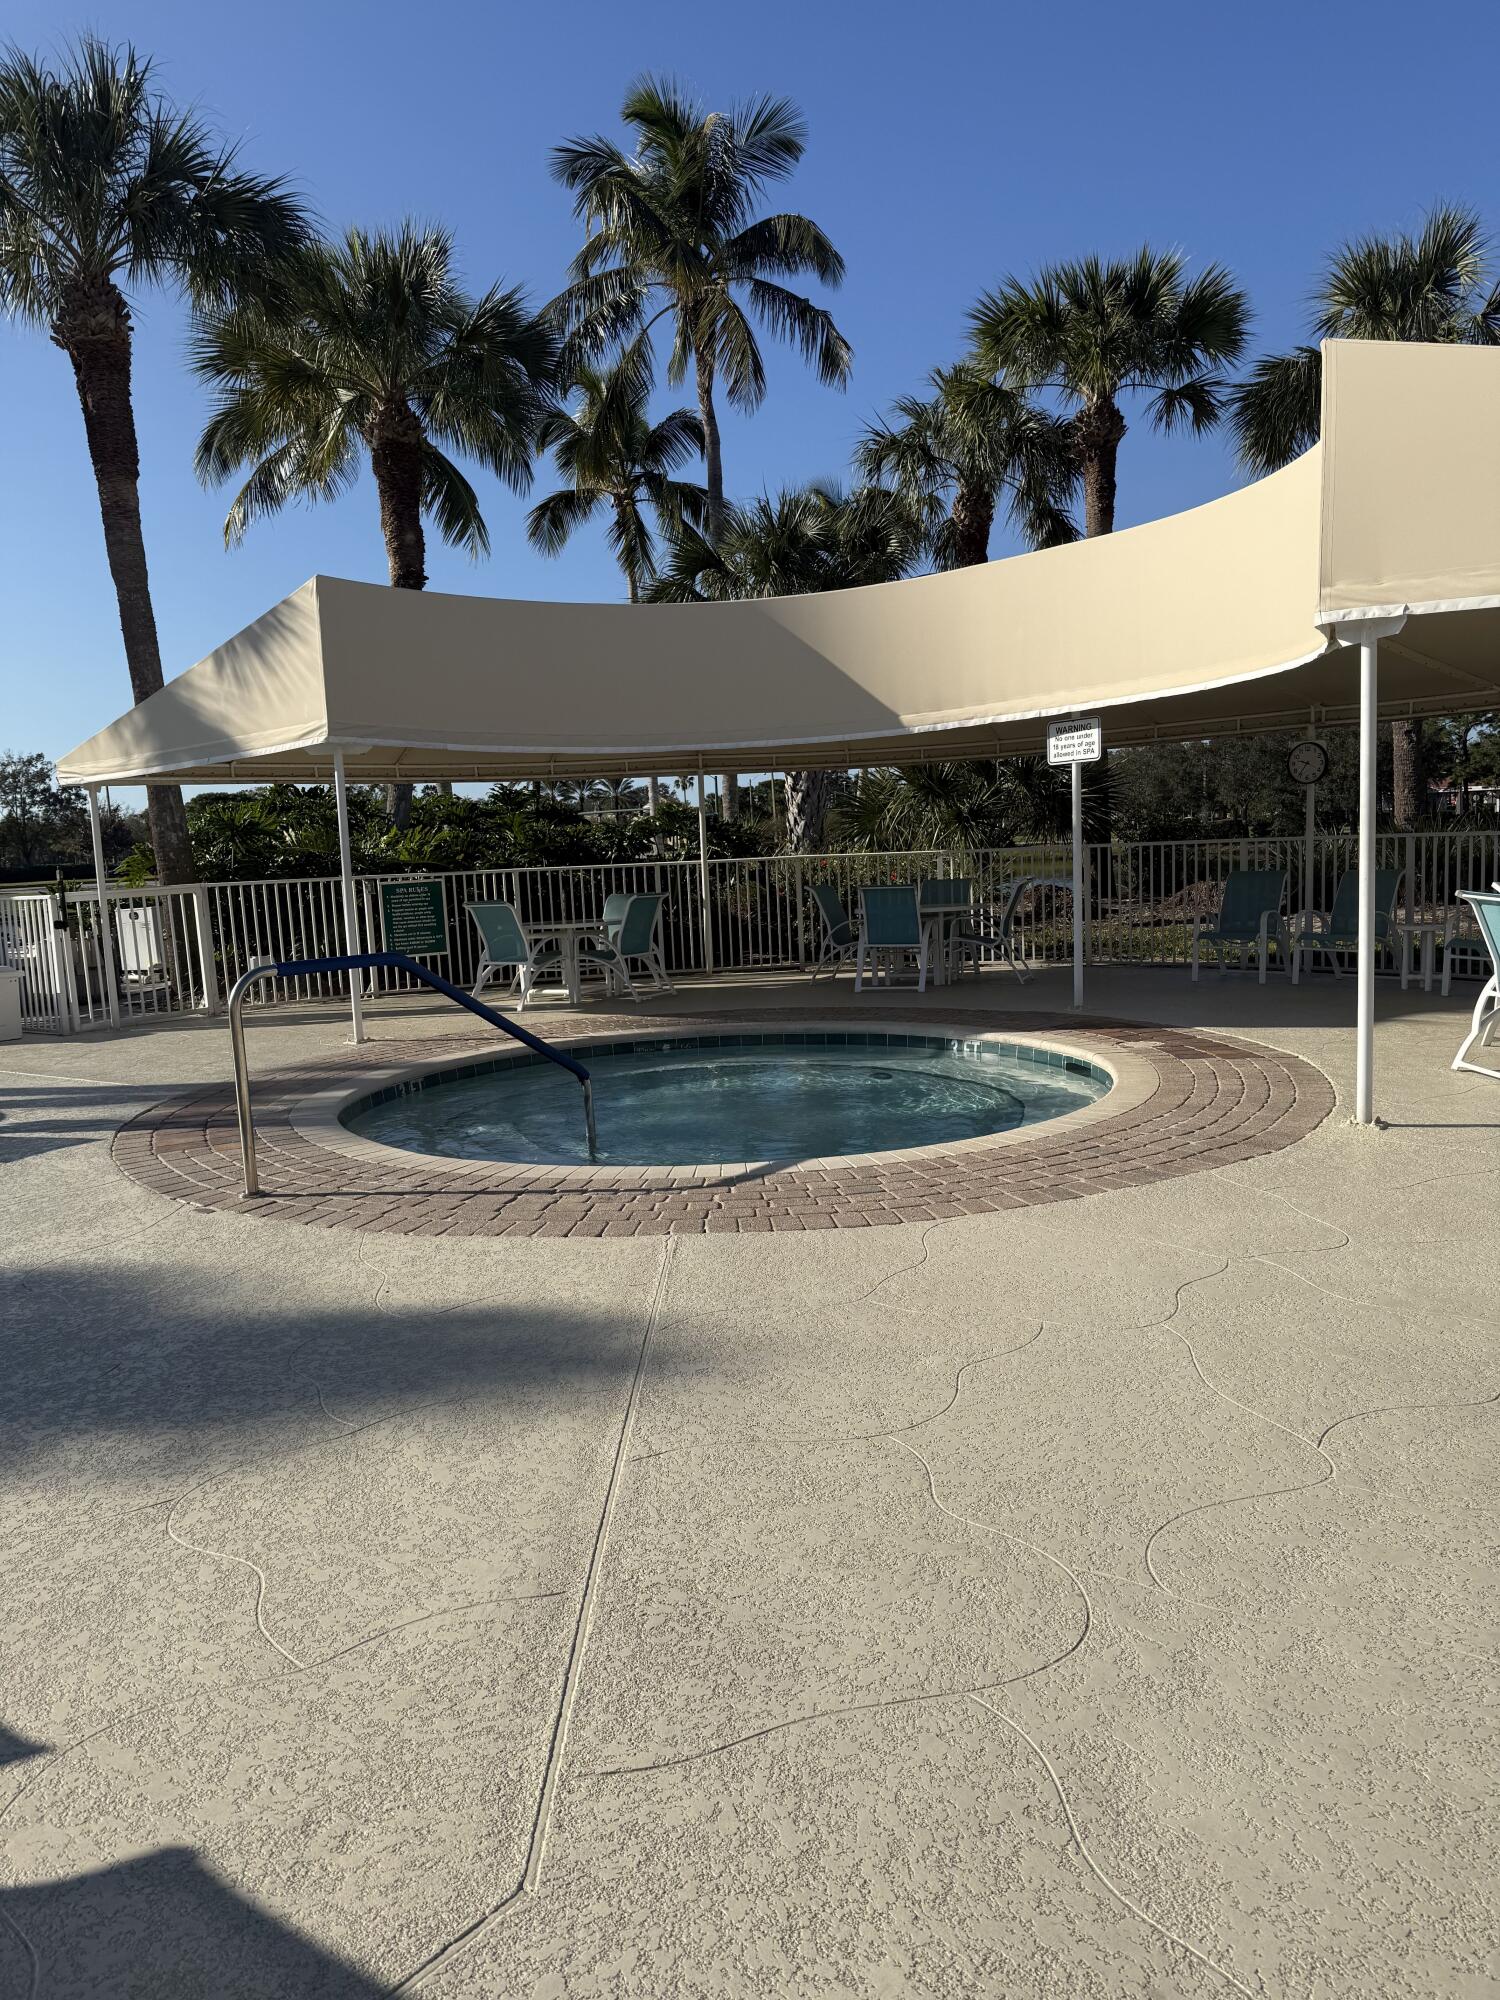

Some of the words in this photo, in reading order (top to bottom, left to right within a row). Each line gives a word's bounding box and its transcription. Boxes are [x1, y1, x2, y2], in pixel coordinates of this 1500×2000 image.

[1056, 723, 1092, 735] WARNING
[1060, 743, 1075, 751] years
[1083, 747, 1095, 755] SPA
